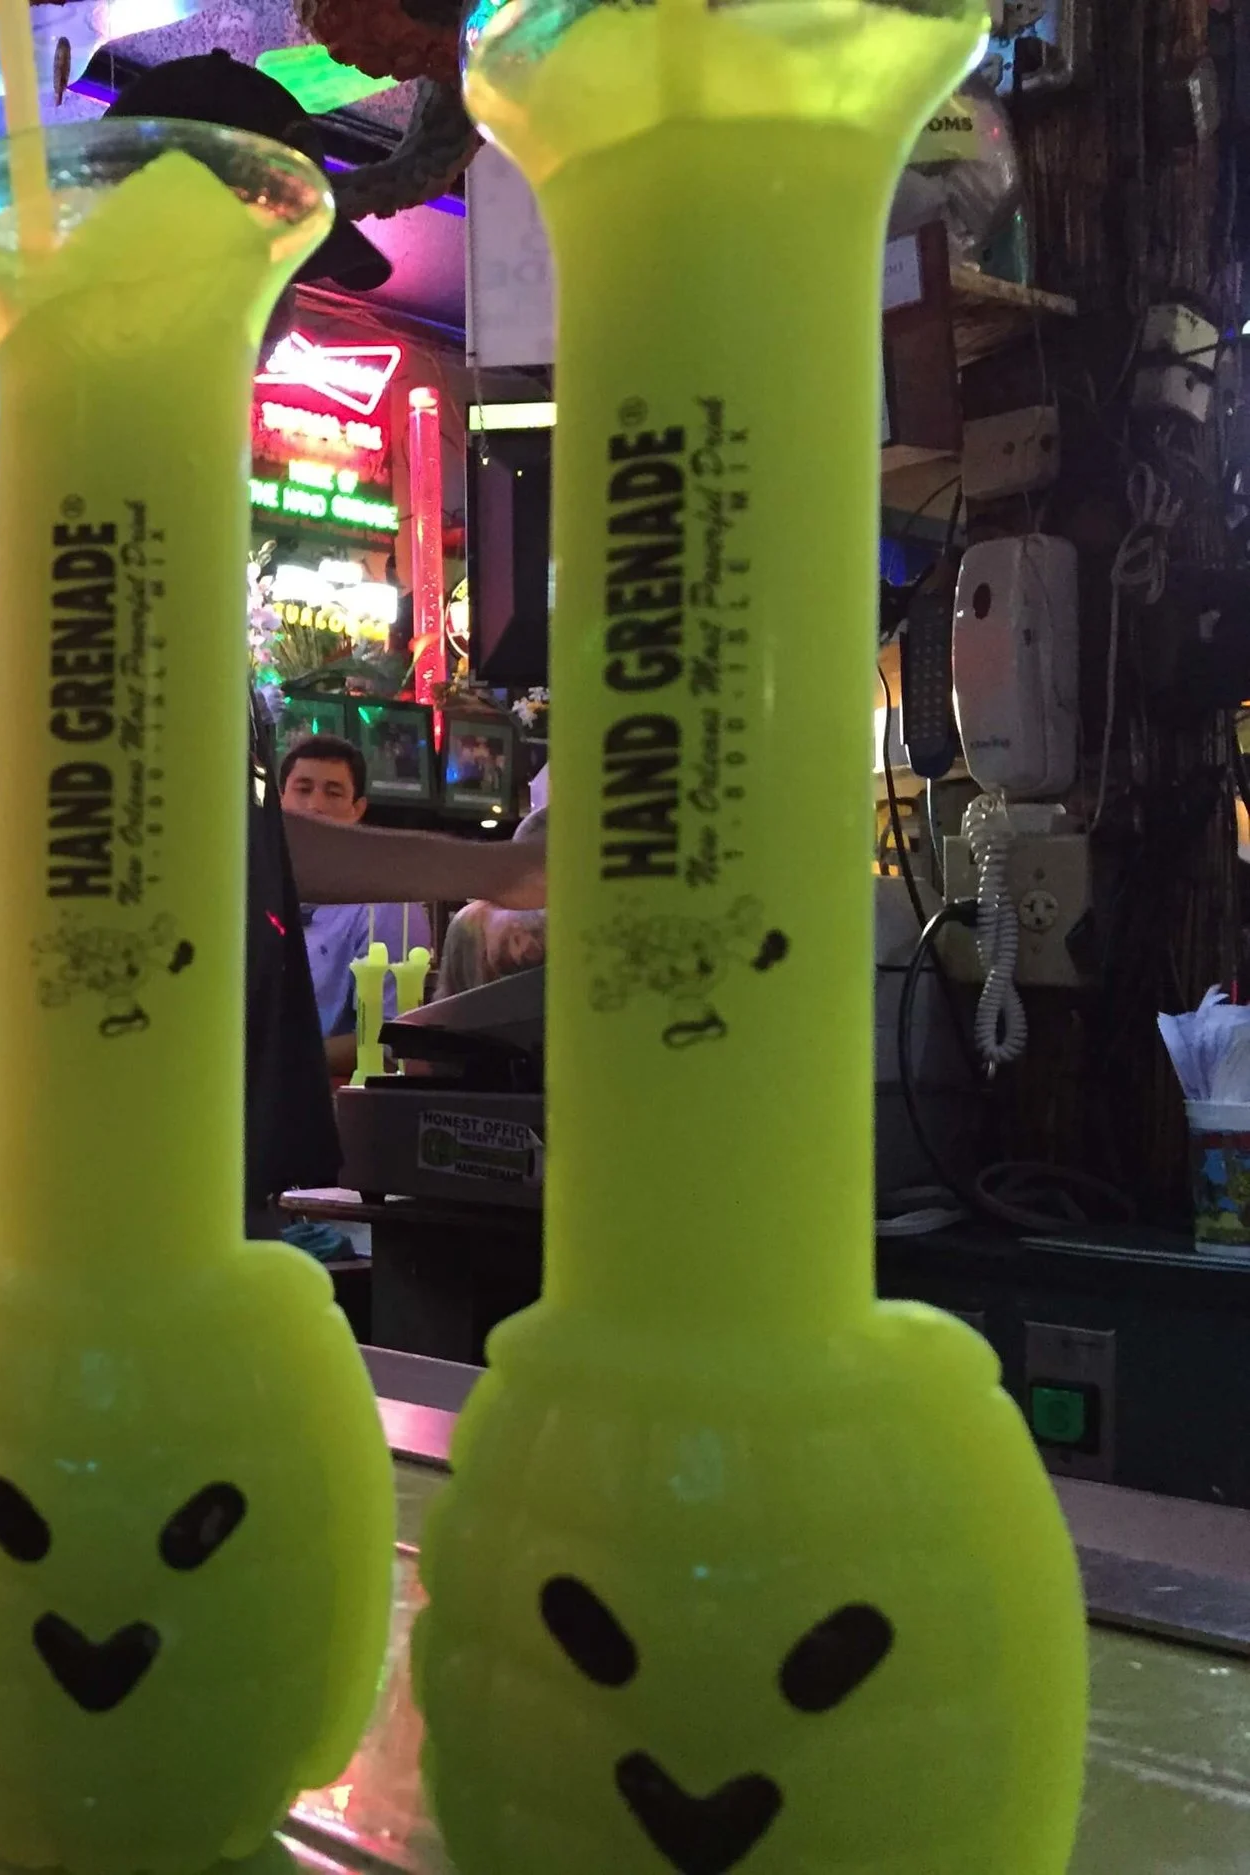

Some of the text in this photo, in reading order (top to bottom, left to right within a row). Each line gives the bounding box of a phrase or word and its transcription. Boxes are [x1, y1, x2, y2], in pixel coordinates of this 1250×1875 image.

[924, 115, 973, 132] OMS
[689, 396, 725, 478] Drink
[120, 498, 147, 566] Drink
[689, 486, 734, 608] Powerful
[688, 619, 723, 700] Most
[118, 691, 146, 752] Most
[47, 761, 115, 899] HAND
[600, 713, 681, 881] HAND
[117, 856, 143, 906] New
[685, 826, 720, 889] New
[423, 1111, 481, 1132] HONEST
